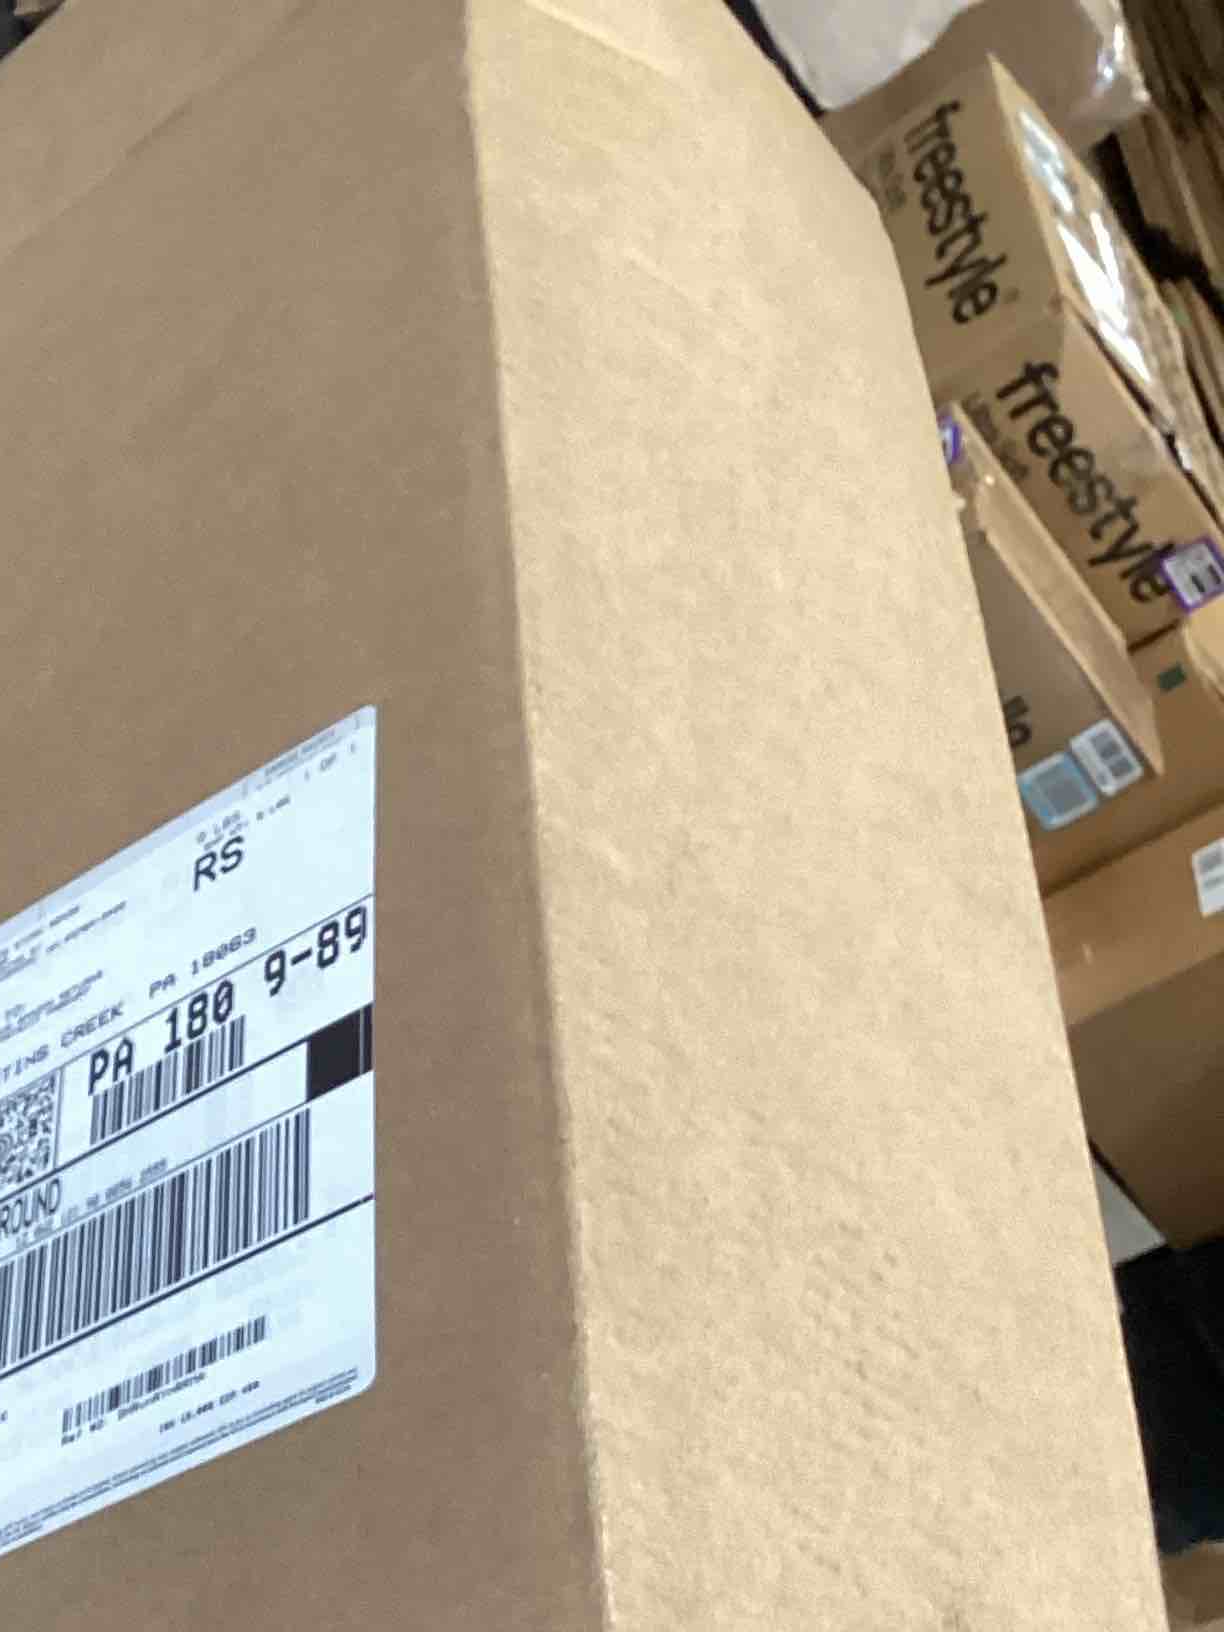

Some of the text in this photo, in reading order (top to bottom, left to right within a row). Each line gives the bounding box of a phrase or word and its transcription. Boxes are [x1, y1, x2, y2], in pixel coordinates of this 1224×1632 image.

[903, 99, 1008, 325] freestyle
[996, 361, 1175, 603] freestyle
[194, 835, 244, 892] RS
[61, 1000, 125, 1048] CREEK
[149, 973, 176, 999] PA
[88, 1036, 135, 1097] PA
[164, 979, 235, 1054] 180
[264, 905, 367, 997] 9-89
